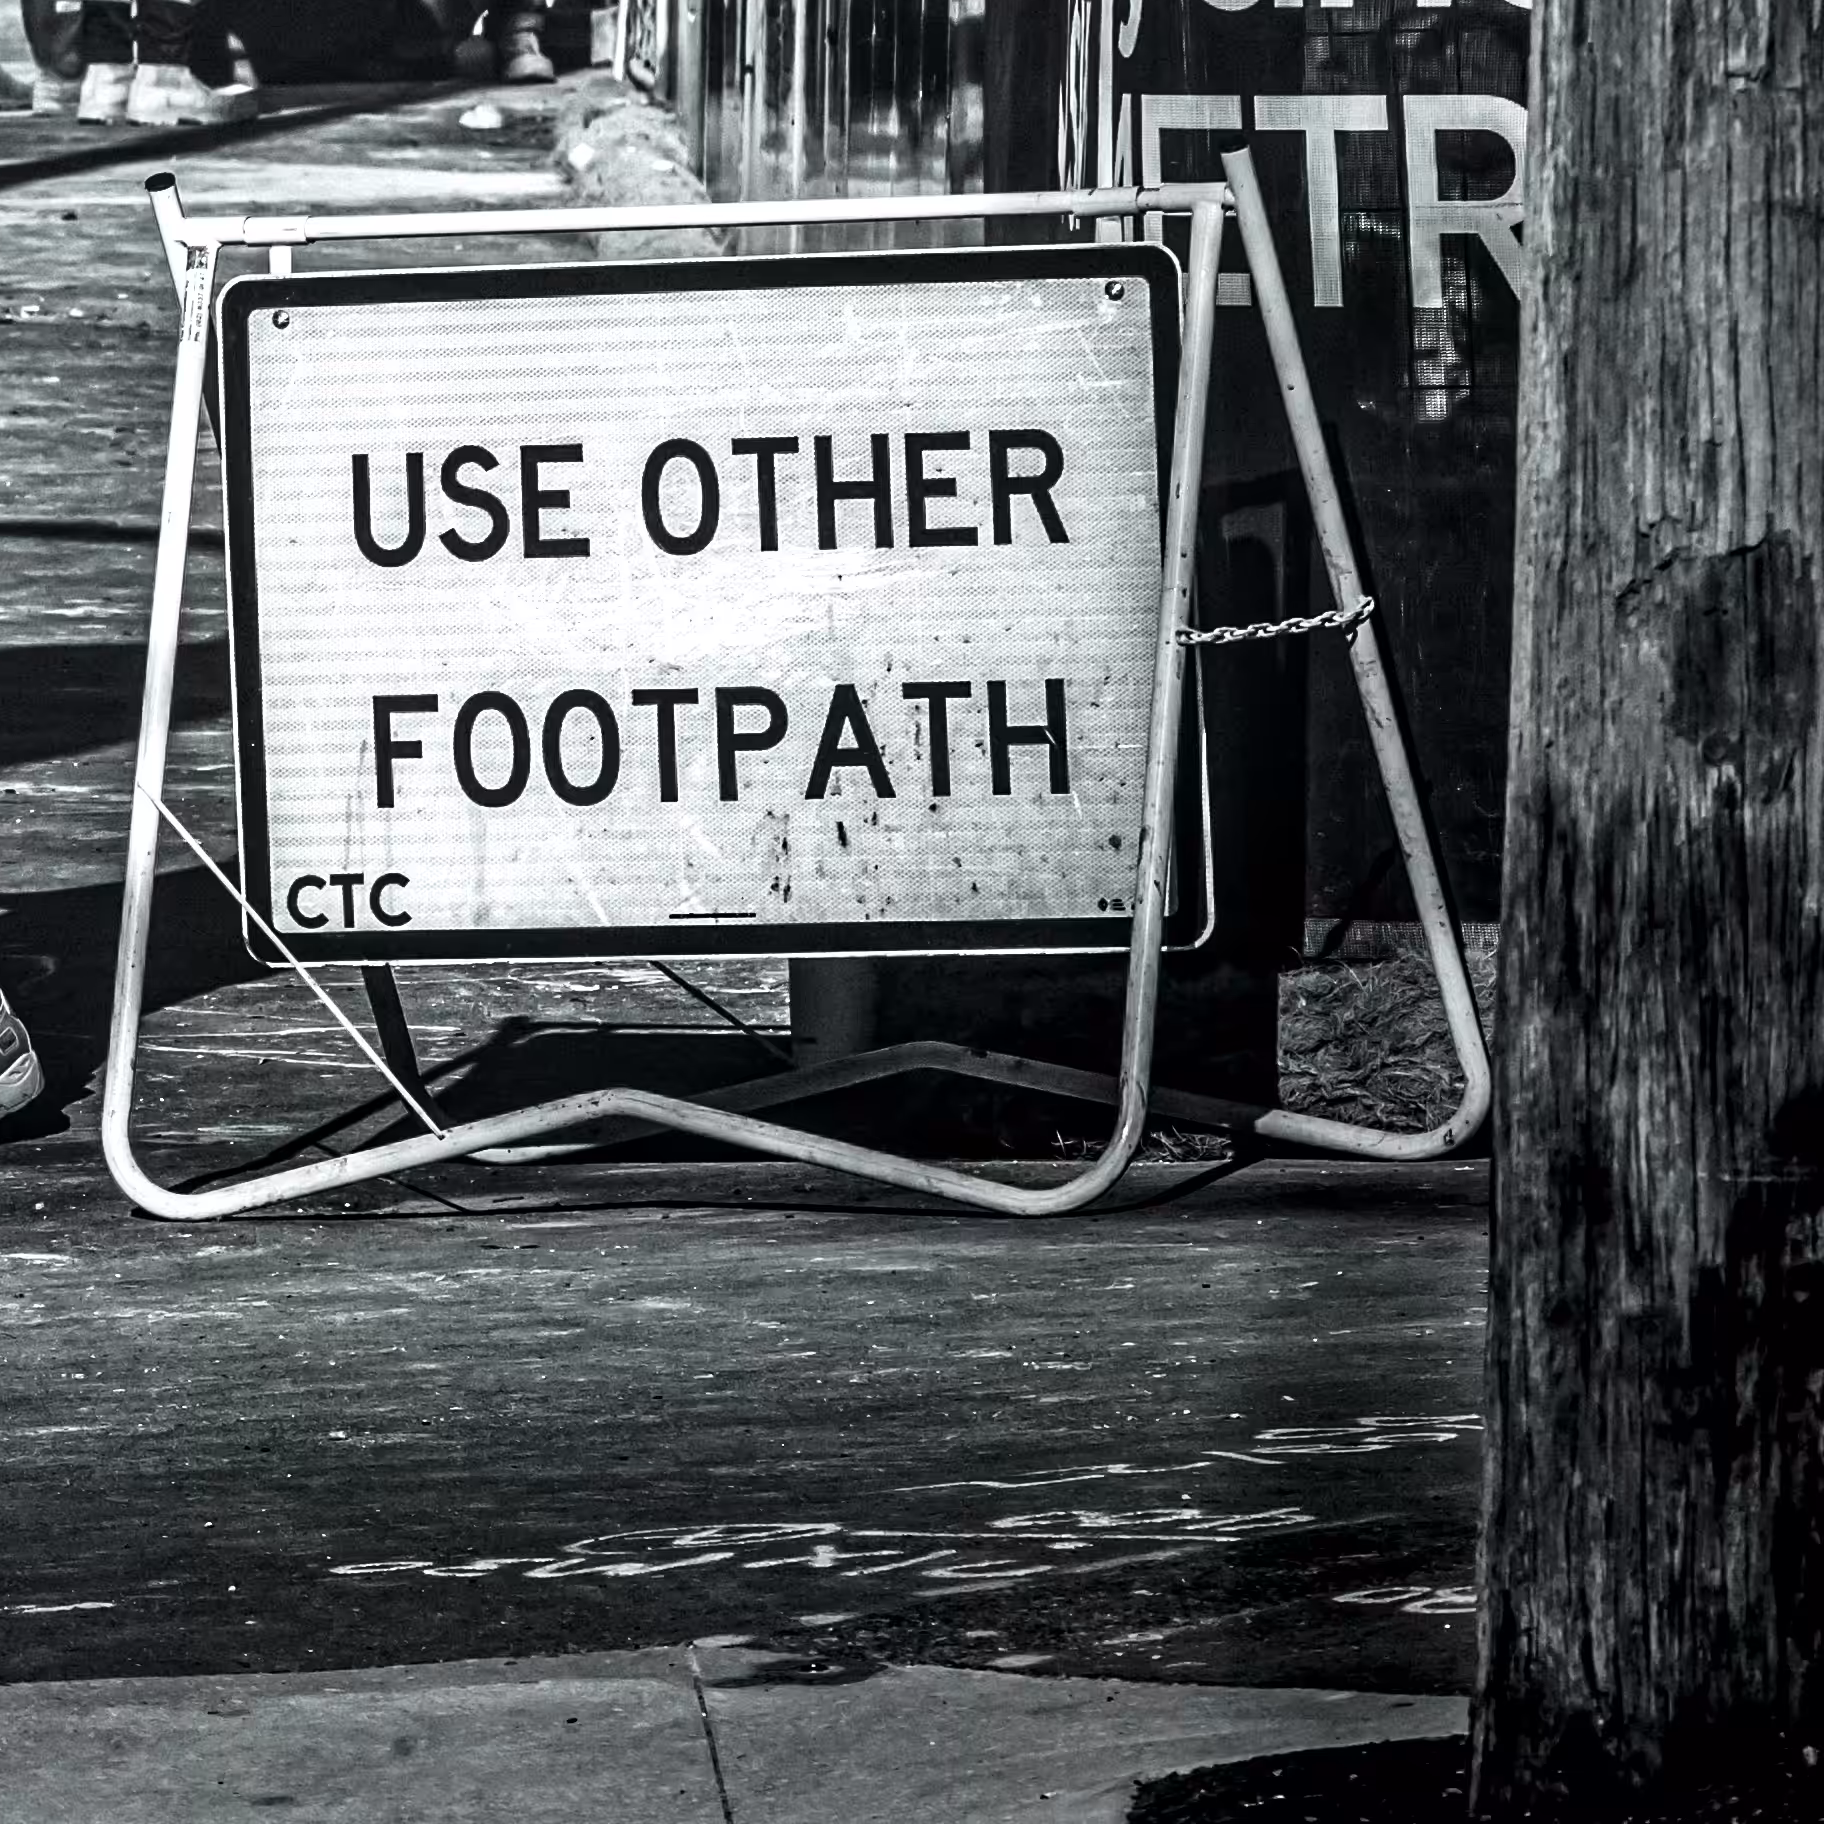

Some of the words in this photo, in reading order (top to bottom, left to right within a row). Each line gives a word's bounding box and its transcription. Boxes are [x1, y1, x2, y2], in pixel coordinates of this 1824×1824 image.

[1114, 94, 1530, 308] ETR
[350, 442, 591, 569] USE
[639, 428, 1070, 556] OTHER
[372, 678, 1071, 809] FOOTPATH
[285, 871, 412, 930] CTC
